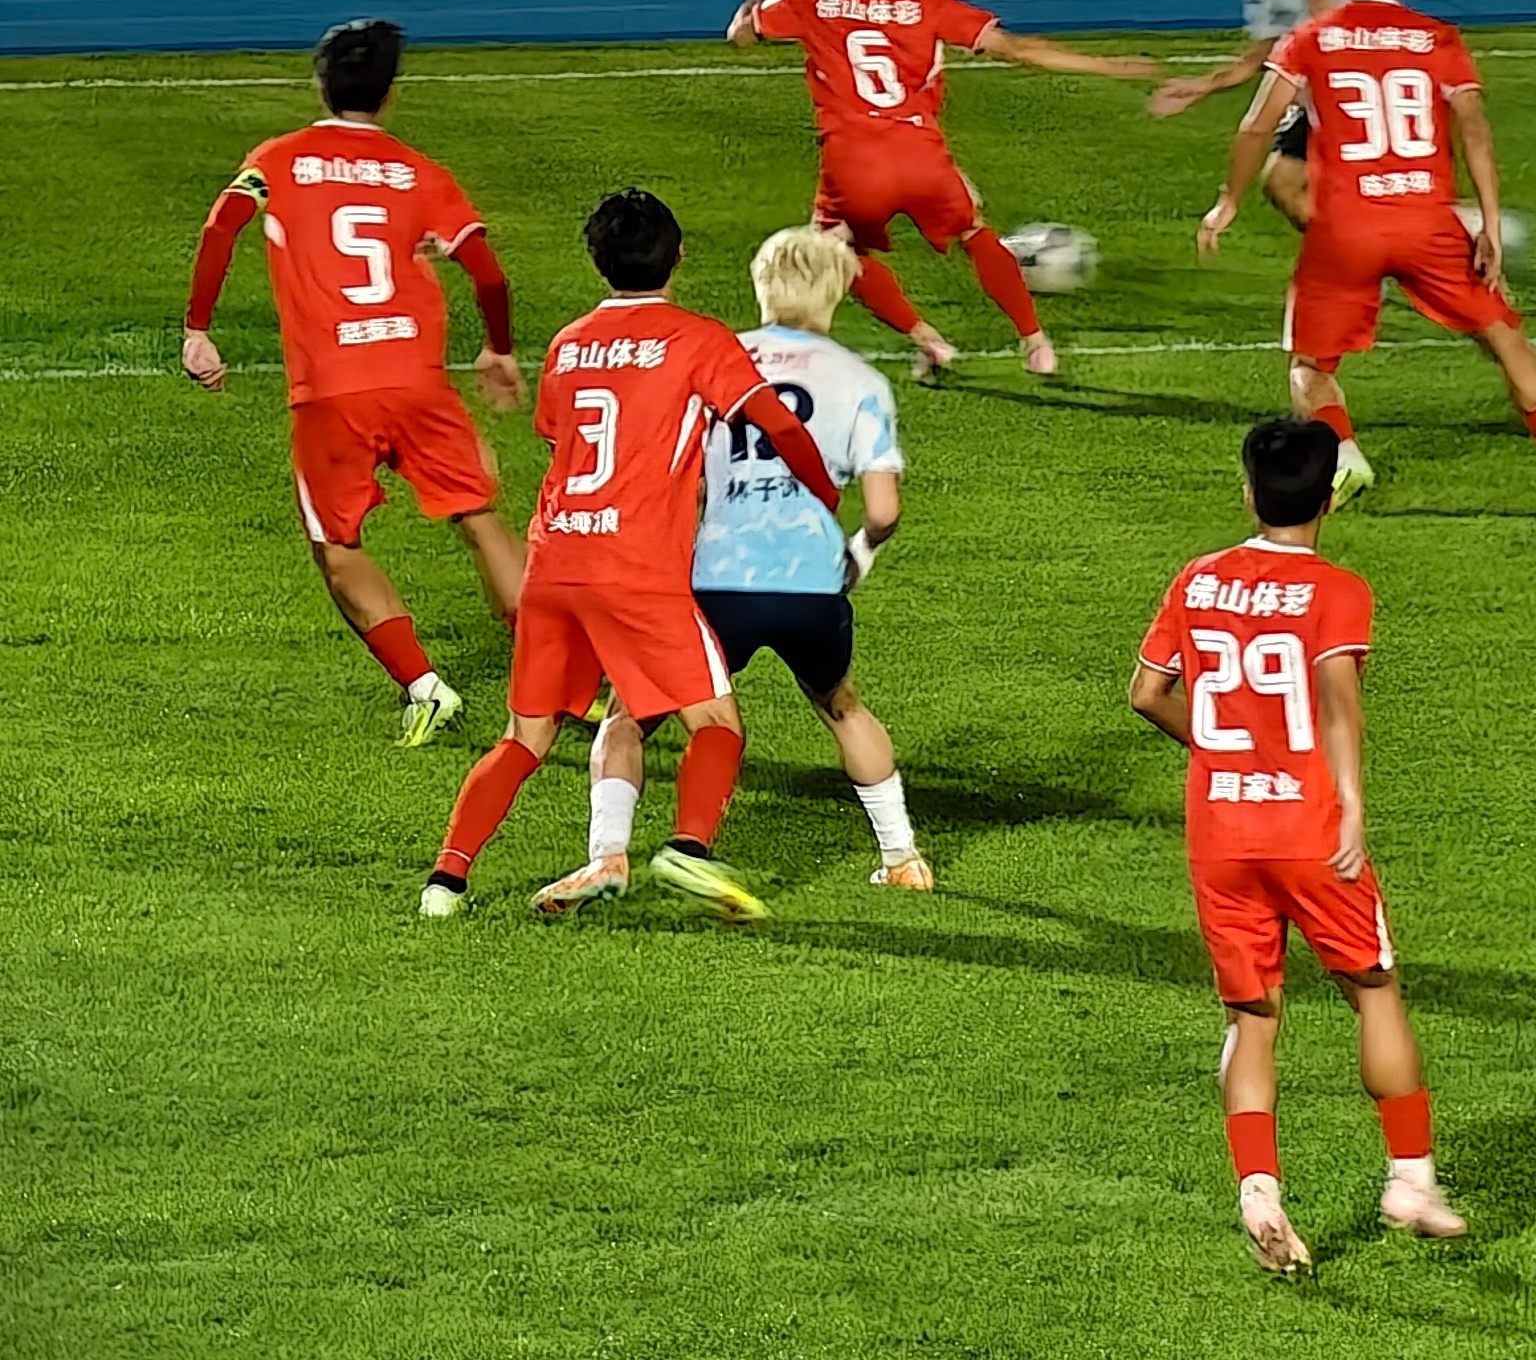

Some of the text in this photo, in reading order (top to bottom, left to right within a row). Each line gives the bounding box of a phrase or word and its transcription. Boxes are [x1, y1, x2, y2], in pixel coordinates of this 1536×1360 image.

[846, 30, 907, 108] 6
[1328, 69, 1437, 161] 38
[331, 204, 396, 305] 5
[565, 389, 617, 496] 3
[1189, 629, 1315, 752] 29
